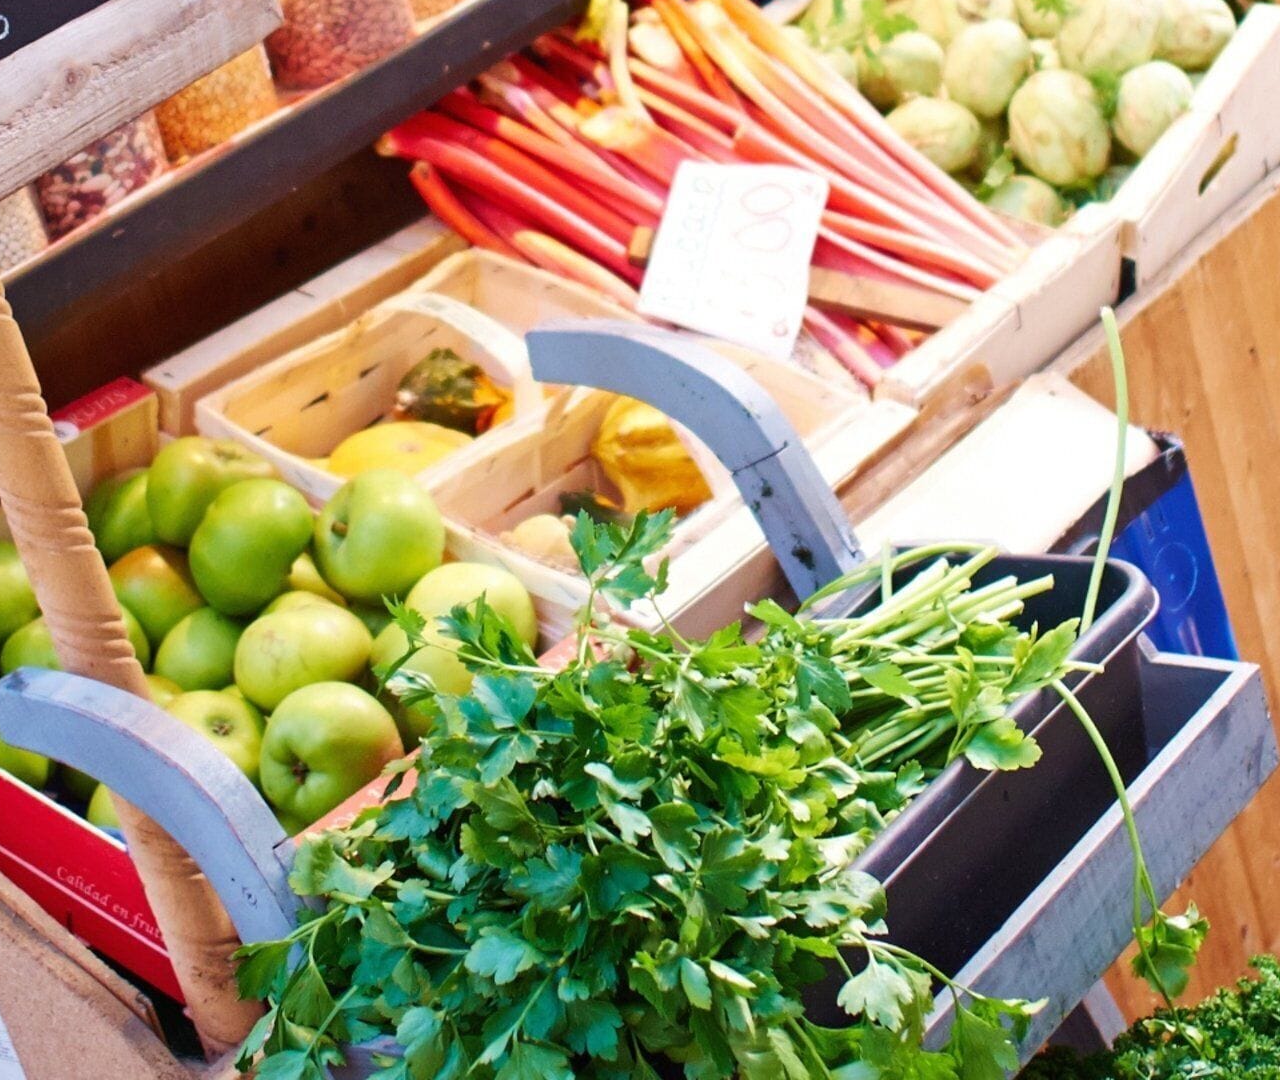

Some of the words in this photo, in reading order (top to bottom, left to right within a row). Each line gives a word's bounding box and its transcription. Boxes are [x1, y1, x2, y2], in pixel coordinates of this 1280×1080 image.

[57, 866, 112, 907] Calidad
[112, 904, 130, 919] en
[129, 912, 161, 939] frut
